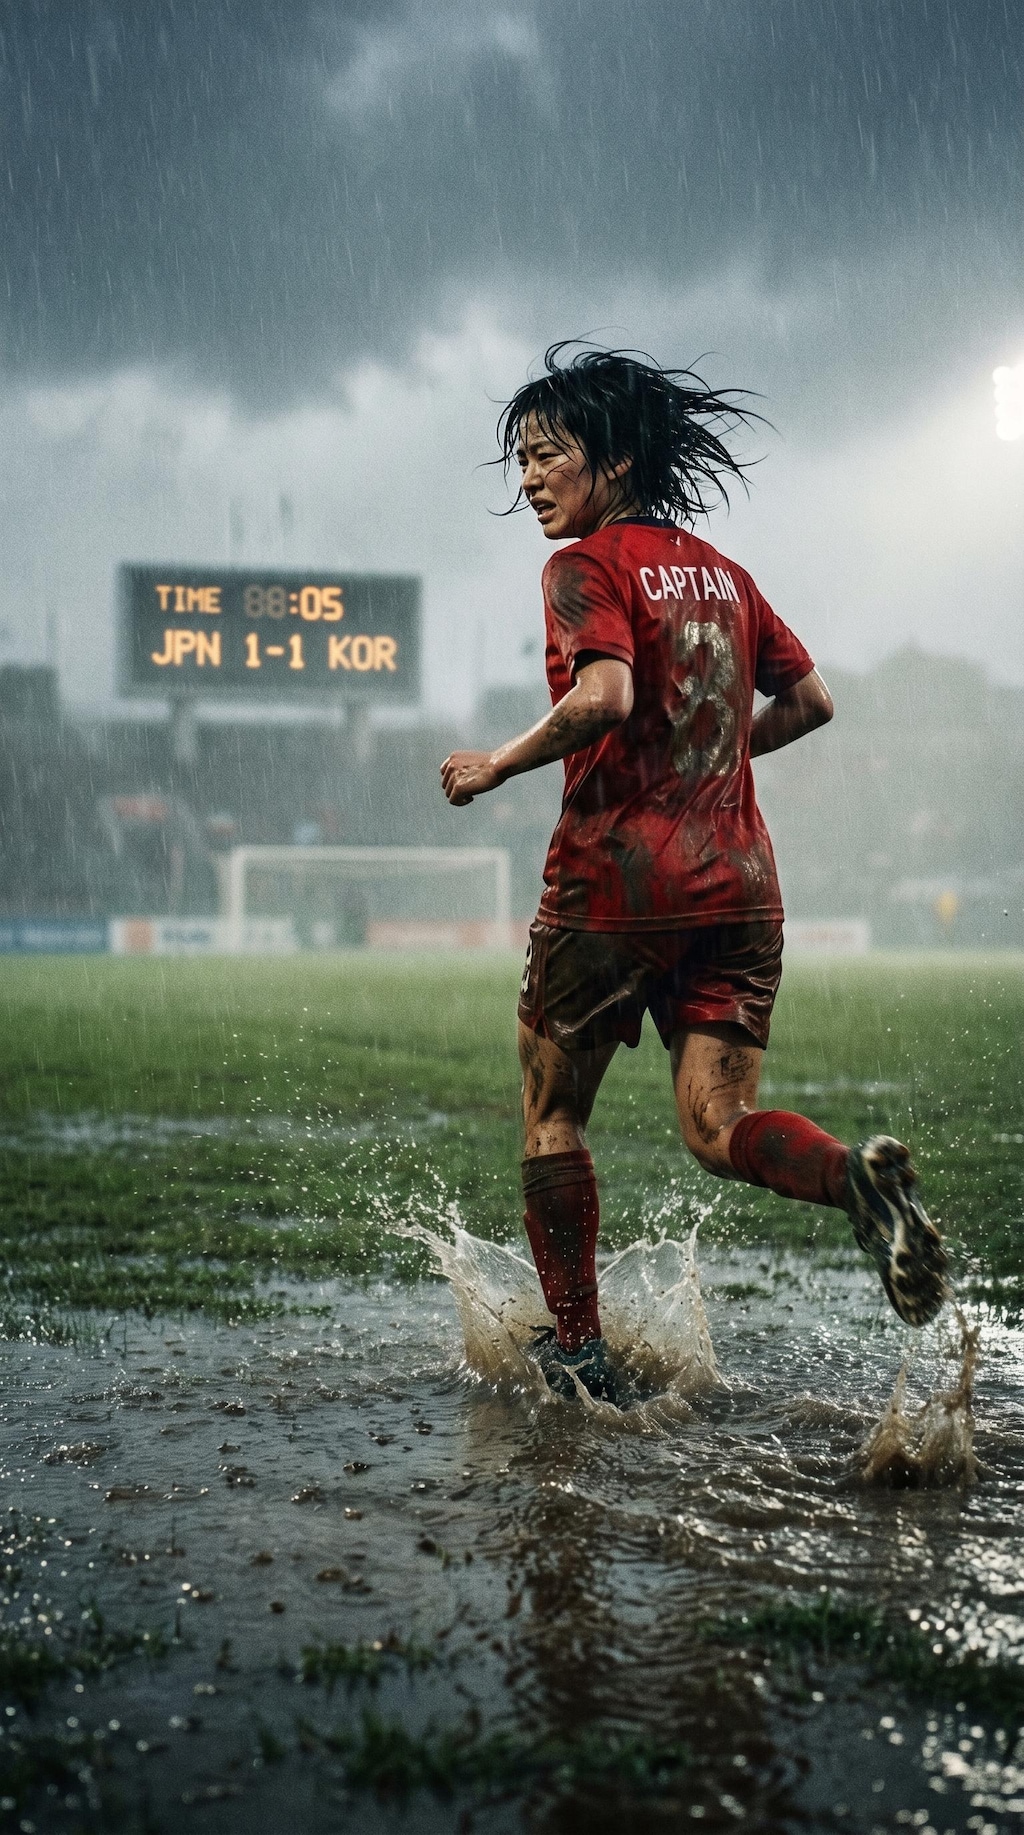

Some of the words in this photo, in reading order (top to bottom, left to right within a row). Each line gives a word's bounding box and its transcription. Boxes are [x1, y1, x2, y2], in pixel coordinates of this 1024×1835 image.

[154, 584, 222, 614] TIME
[245, 584, 344, 622] 88:05
[639, 564, 741, 604] CAPTAIN
[151, 628, 222, 667] JPN
[245, 632, 305, 669] 1-1
[328, 634, 398, 672] KOR
